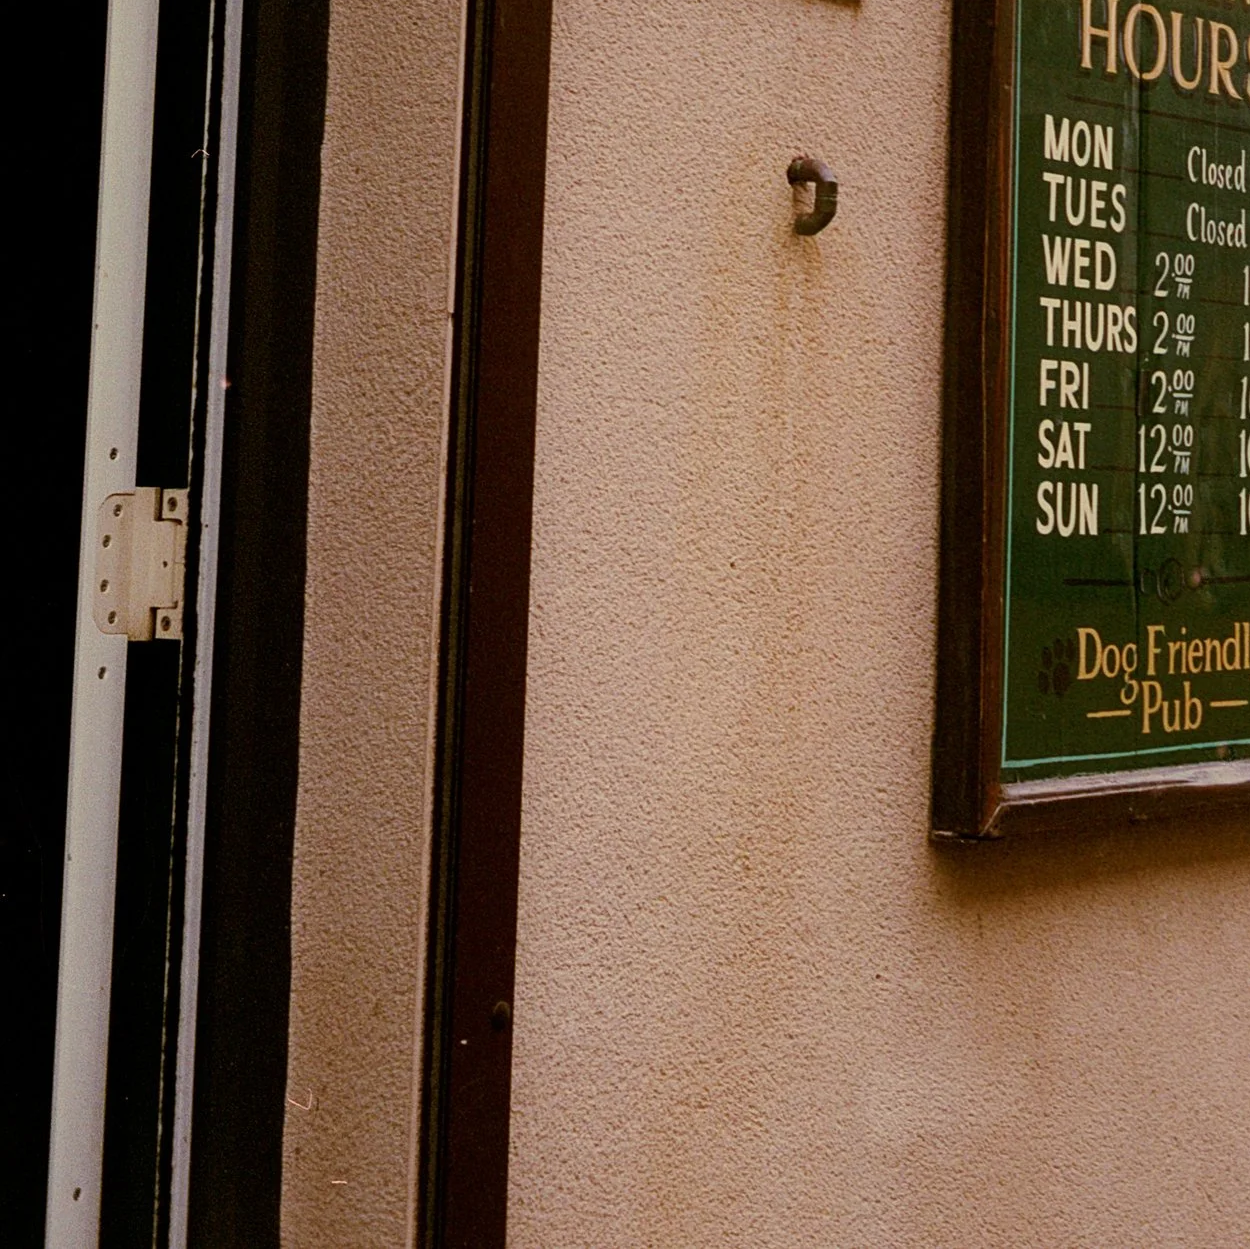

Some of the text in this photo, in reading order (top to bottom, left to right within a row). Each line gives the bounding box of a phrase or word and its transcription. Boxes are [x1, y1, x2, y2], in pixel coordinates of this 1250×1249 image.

[1043, 114, 1247, 193] MON Closed
[1042, 172, 1248, 249] TUES Closed
[1042, 234, 1117, 291] WED
[1040, 297, 1138, 354] THURS
[1040, 359, 1089, 410] FRI
[1038, 419, 1091, 469] SAT
[1036, 481, 1098, 537] SUN
[1076, 627, 1139, 705] Dog
[1142, 681, 1202, 734] Pub
